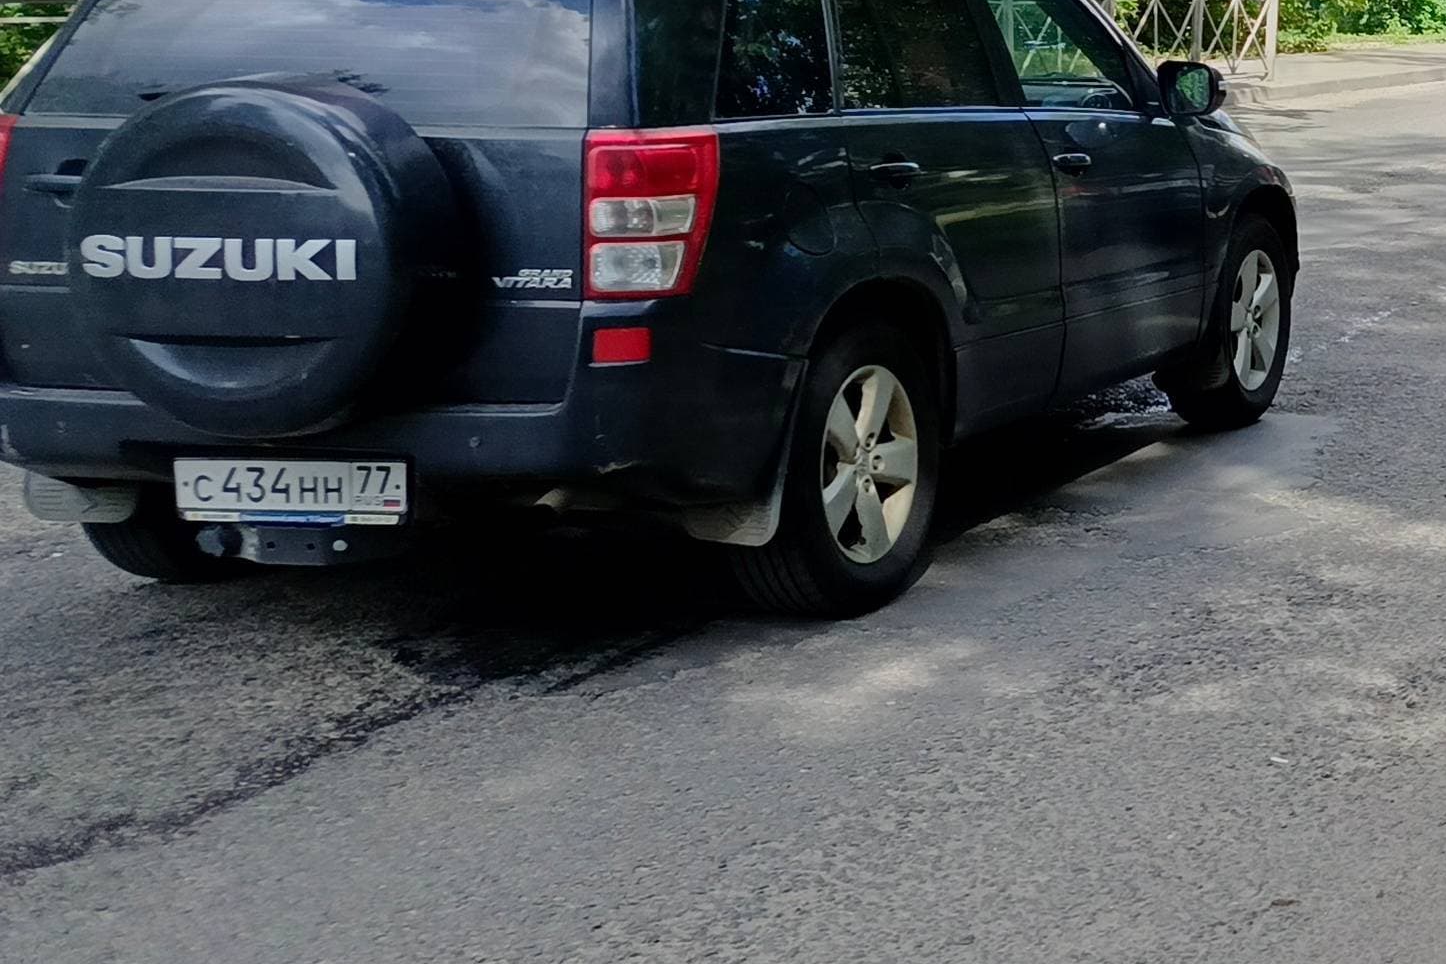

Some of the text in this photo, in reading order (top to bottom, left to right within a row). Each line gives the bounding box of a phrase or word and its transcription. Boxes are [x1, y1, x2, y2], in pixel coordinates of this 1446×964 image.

[9, 260, 69, 275] SUZU
[80, 234, 357, 281] SUZUKI
[491, 276, 572, 289] VITARA
[356, 466, 391, 494] 77
